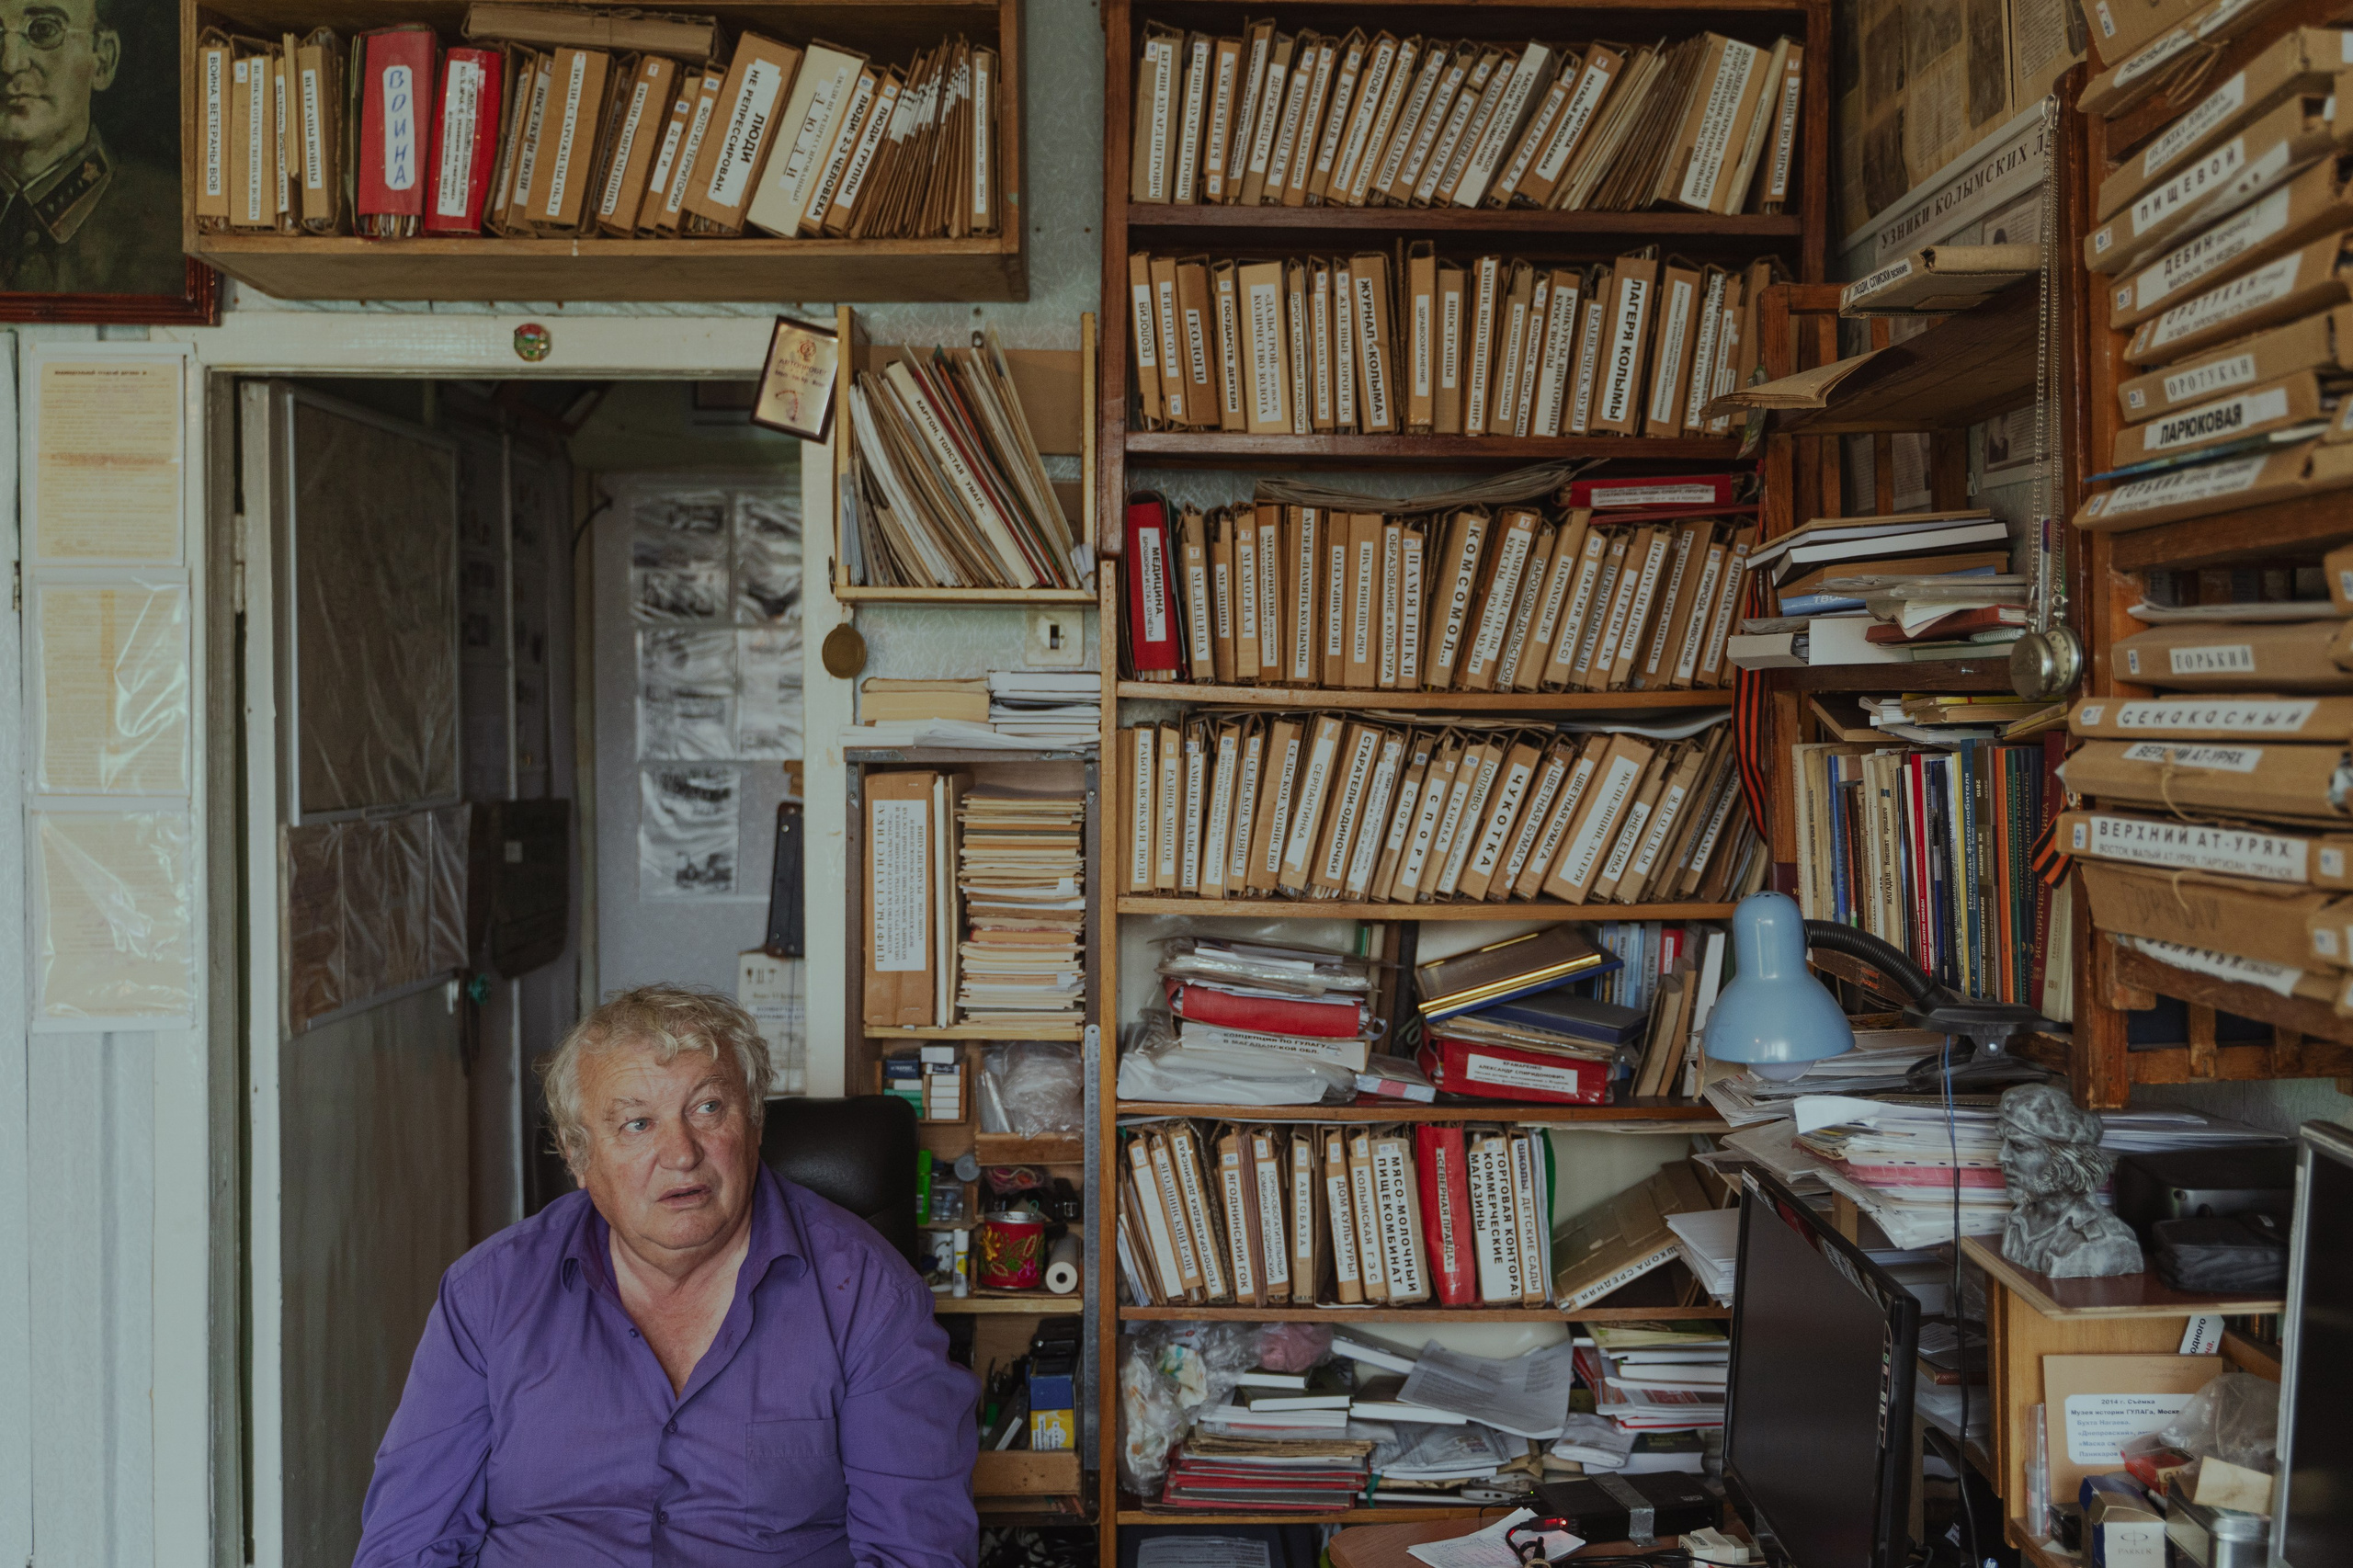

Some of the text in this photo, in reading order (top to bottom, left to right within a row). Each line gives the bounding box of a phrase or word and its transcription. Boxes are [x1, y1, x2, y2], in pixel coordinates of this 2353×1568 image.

[1258, 76, 1282, 141] ДЕРЕЖЕНЕЦ
[1366, 50, 1392, 94] КОЗЛОВ
[304, 76, 317, 182] ВЕТЕРАНЫ ВОЙНЫ
[694, 107, 710, 132] ФОТО
[712, 70, 760, 195] НЕ РЕПРЕССИРОВАН.
[740, 112, 767, 163] ЛЮДИ
[845, 95, 870, 134] ЛЮДИ:
[1153, 51, 1170, 198] БЕРЗИН ЭДУАРД ПЕТРОВИЧ
[1181, 53, 1204, 199] БЕРЗИН ЭДУАРД ПЕТРОВИЧ
[1306, 97, 1319, 127] ВАДИМ
[1326, 83, 1351, 139] КОЗЛОВ
[1416, 89, 1452, 153] МЕДВЕДЬ
[1432, 102, 1471, 169] СНЕЖКОВ
[1539, 74, 1597, 170] НАТАЛЬЯ НИКОЛАЕВНА
[1563, 106, 1592, 148] ХАЮТИНА
[813, 156, 846, 216] ЧЕЛОВЕКА
[844, 108, 889, 195] ЛЮДИ: ГРУППЫ
[1934, 142, 2028, 216] КОЛЫМСКИХ
[2141, 145, 2235, 222] ПИЩЕВОЙ
[1139, 302, 1152, 358] ГЕОЛОГИЯ
[1163, 291, 1176, 369] ГЕОЛОГИЯ
[1188, 312, 1205, 381] ГЕОЛОГИ
[1224, 301, 1237, 410] ГОСУДАРСТВ. ДЕЯТЕЛИ
[1254, 295, 1268, 415] КОЛИЧЕСТВО ЗОЛОТА
[1293, 332, 1302, 380] НАЗЕМНЫЙ
[1359, 280, 1385, 421] ЖУРНАЛ «КОЛЫМА»
[1545, 295, 1563, 369] КРОССВОРДЫ
[1608, 279, 1642, 419] ЛАГЕРЯ КОЛЫМЫ
[1340, 358, 1350, 403] ДОРОГИ
[2169, 358, 2249, 398] ОРОТУКАН
[915, 400, 965, 475] КАРТОН, ТОЛСТАЯ
[1142, 536, 1151, 576] БРОШЮРЫ
[1152, 547, 1164, 618] МЕДИЦИНА,
[1244, 552, 1254, 633] МЕМОРИАЛ
[1194, 573, 1206, 653] МЕДИЦИНА
[1219, 572, 1228, 634] МЕДИЦИНА
[1331, 551, 1342, 649] НЕ ОТ МИРА СЕГО
[1385, 534, 1397, 678] ОБРАЗОВАНИЕ КУЛЬТУРА
[1404, 555, 1418, 675] ПАМЯТНИКИ
[1502, 558, 1544, 683] ПАРОХОДЫ ДАЛЬСТРОЯ
[1297, 610, 1309, 668] КОЛЫМЫ»
[2175, 647, 2250, 670] ГОРЬКИЙ
[2121, 708, 2302, 727] СЕНОКОСНЫЙ
[1138, 743, 1149, 879] РАБОТА ВСЯКАЯ ЛЮДИ
[1295, 763, 1324, 839] СЕРПАНТИНКА
[1328, 735, 1373, 873] СТАРАТЕЛИ-ОДИНОЧКИ
[1392, 790, 1415, 839] СПОРТ
[1438, 790, 1465, 844] ТЕХНИКА
[1469, 763, 1496, 812] ТОПЛИВО
[1479, 775, 1525, 866] ЧУКОТКА
[1538, 773, 1587, 860] ЦВЕТНАЯ БУМАГА
[1881, 807, 1890, 834] прошлого
[1407, 794, 1439, 874] СПОРТ
[1509, 824, 1538, 868] БУМАГА
[1608, 811, 1645, 873] ЭНЕРГЕТИКА
[1640, 795, 1681, 865] ЯПОНЦЫ
[1963, 772, 1974, 910] Исповедь фотолюбителя
[2099, 821, 2188, 845] ВЕРХНИЙ
[1884, 870, 1893, 904] МАГАДАН.
[1177, 1140, 1217, 1288] ГЕОЛОГОРАЗВЕДКА ДЕБИНСКАЯ
[1259, 1171, 1269, 1215] КОМБИНАТ
[1357, 1170, 1373, 1244] КОЛЫМСКАЯ
[1378, 1158, 1403, 1284] ПИЩЕКОМБИНАТ
[1437, 1153, 1449, 1215] «СЕВЕРНАЯ
[1471, 1154, 1485, 1231] МАГАЗИНЫ
[1483, 1153, 1503, 1265] КОММЕРЧЕСКИЕ
[1227, 1173, 1249, 1289] ЯГОДНИНСКИЙ ГОК
[1269, 1170, 1285, 1276] ГОРНО-ОБОГАТИТЕЛЬНЫЙ
[1337, 1181, 1356, 1277] ДОМ КУЛЬТУРЫ:
[1391, 1156, 1416, 1291] МЯСО-МОЛОЧНЫЙ
[1496, 1152, 1519, 1296] ТОРГОВАЯ КОНТОРА:
[1522, 1198, 1540, 1290] ДЕТСКИЕ САДЫ
